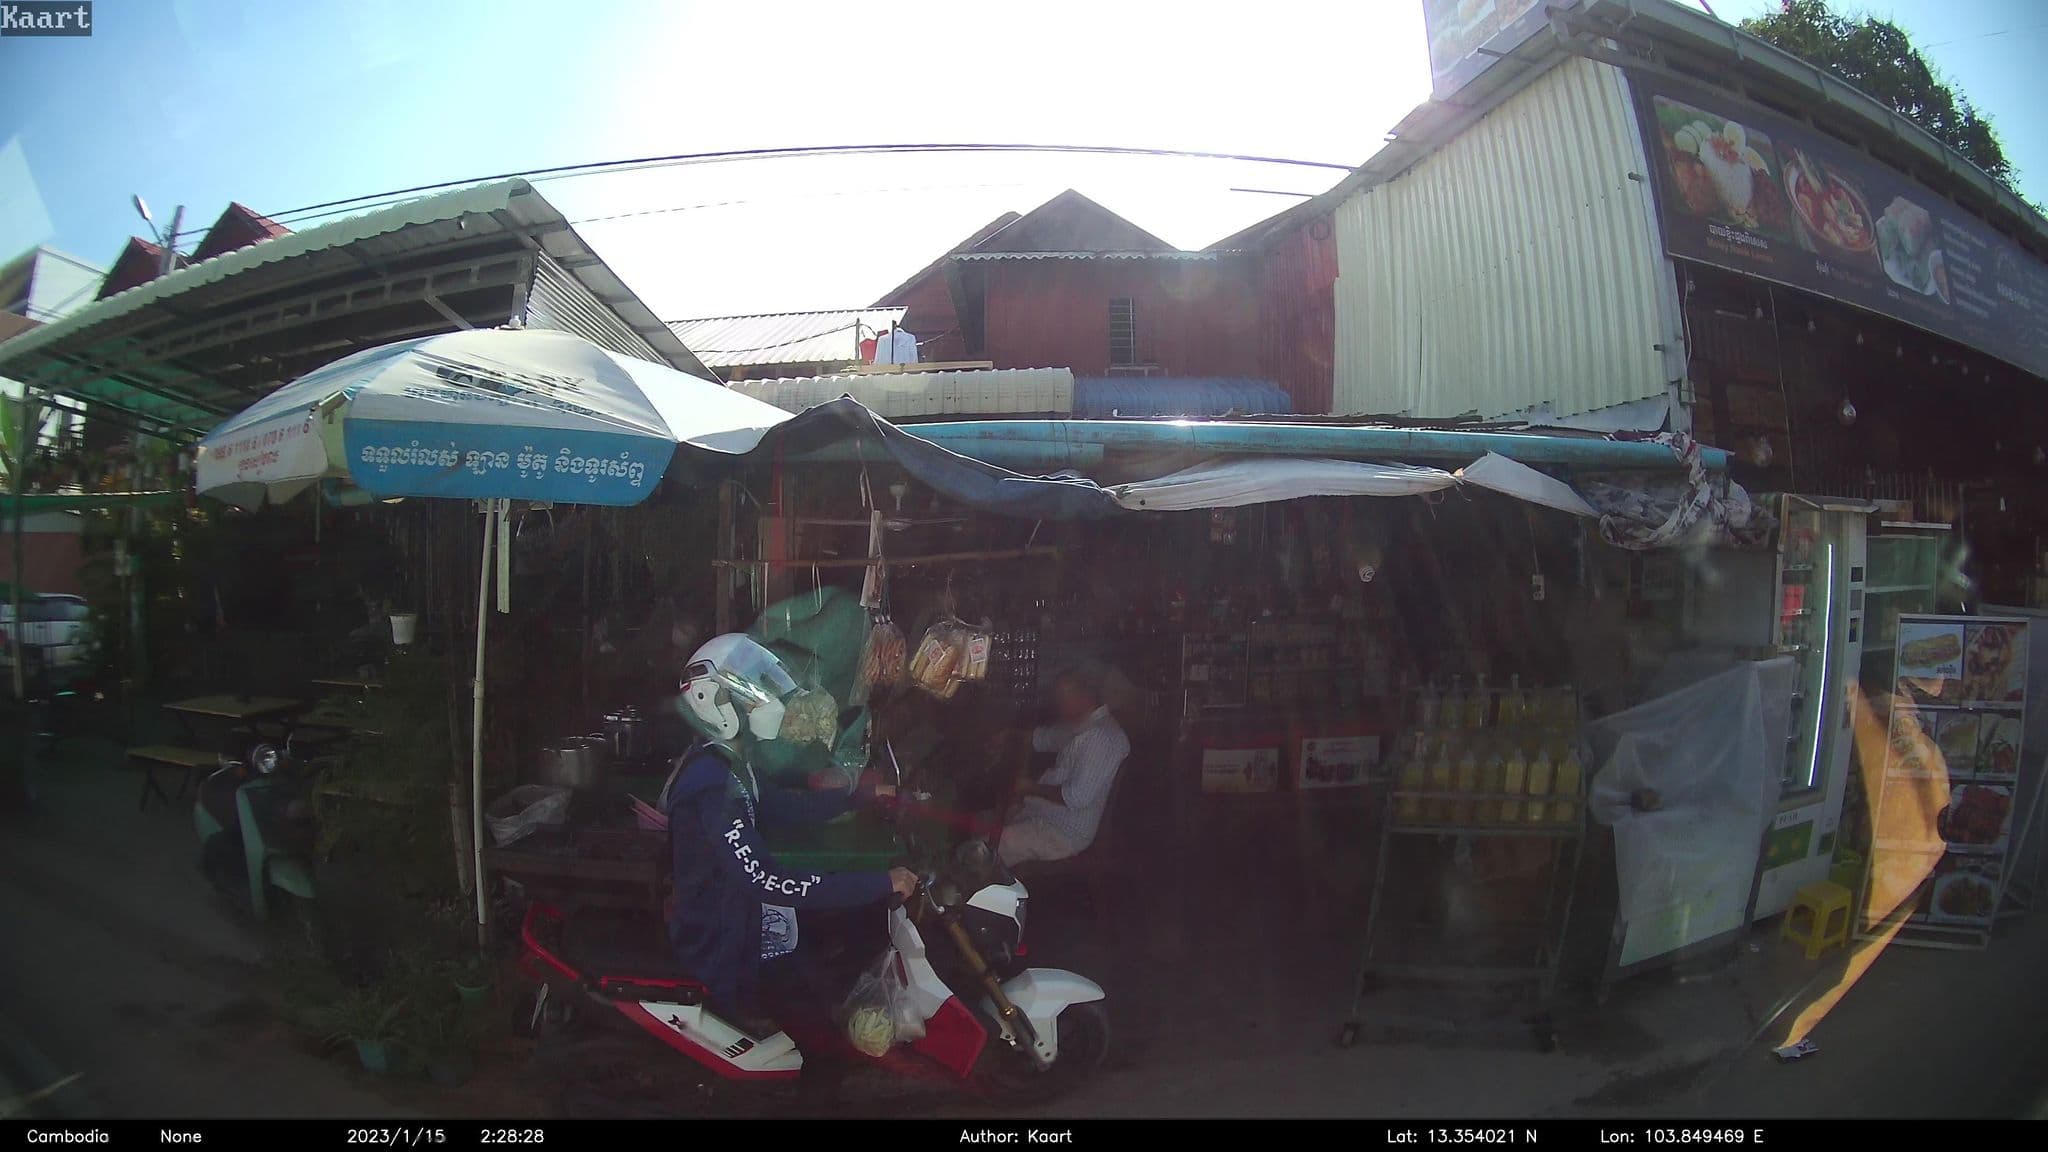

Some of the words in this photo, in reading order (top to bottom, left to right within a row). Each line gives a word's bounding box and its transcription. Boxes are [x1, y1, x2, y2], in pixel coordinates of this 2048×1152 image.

[361, 440, 459, 473] ទទួលរំលស់
[464, 450, 510, 475] ឡាន
